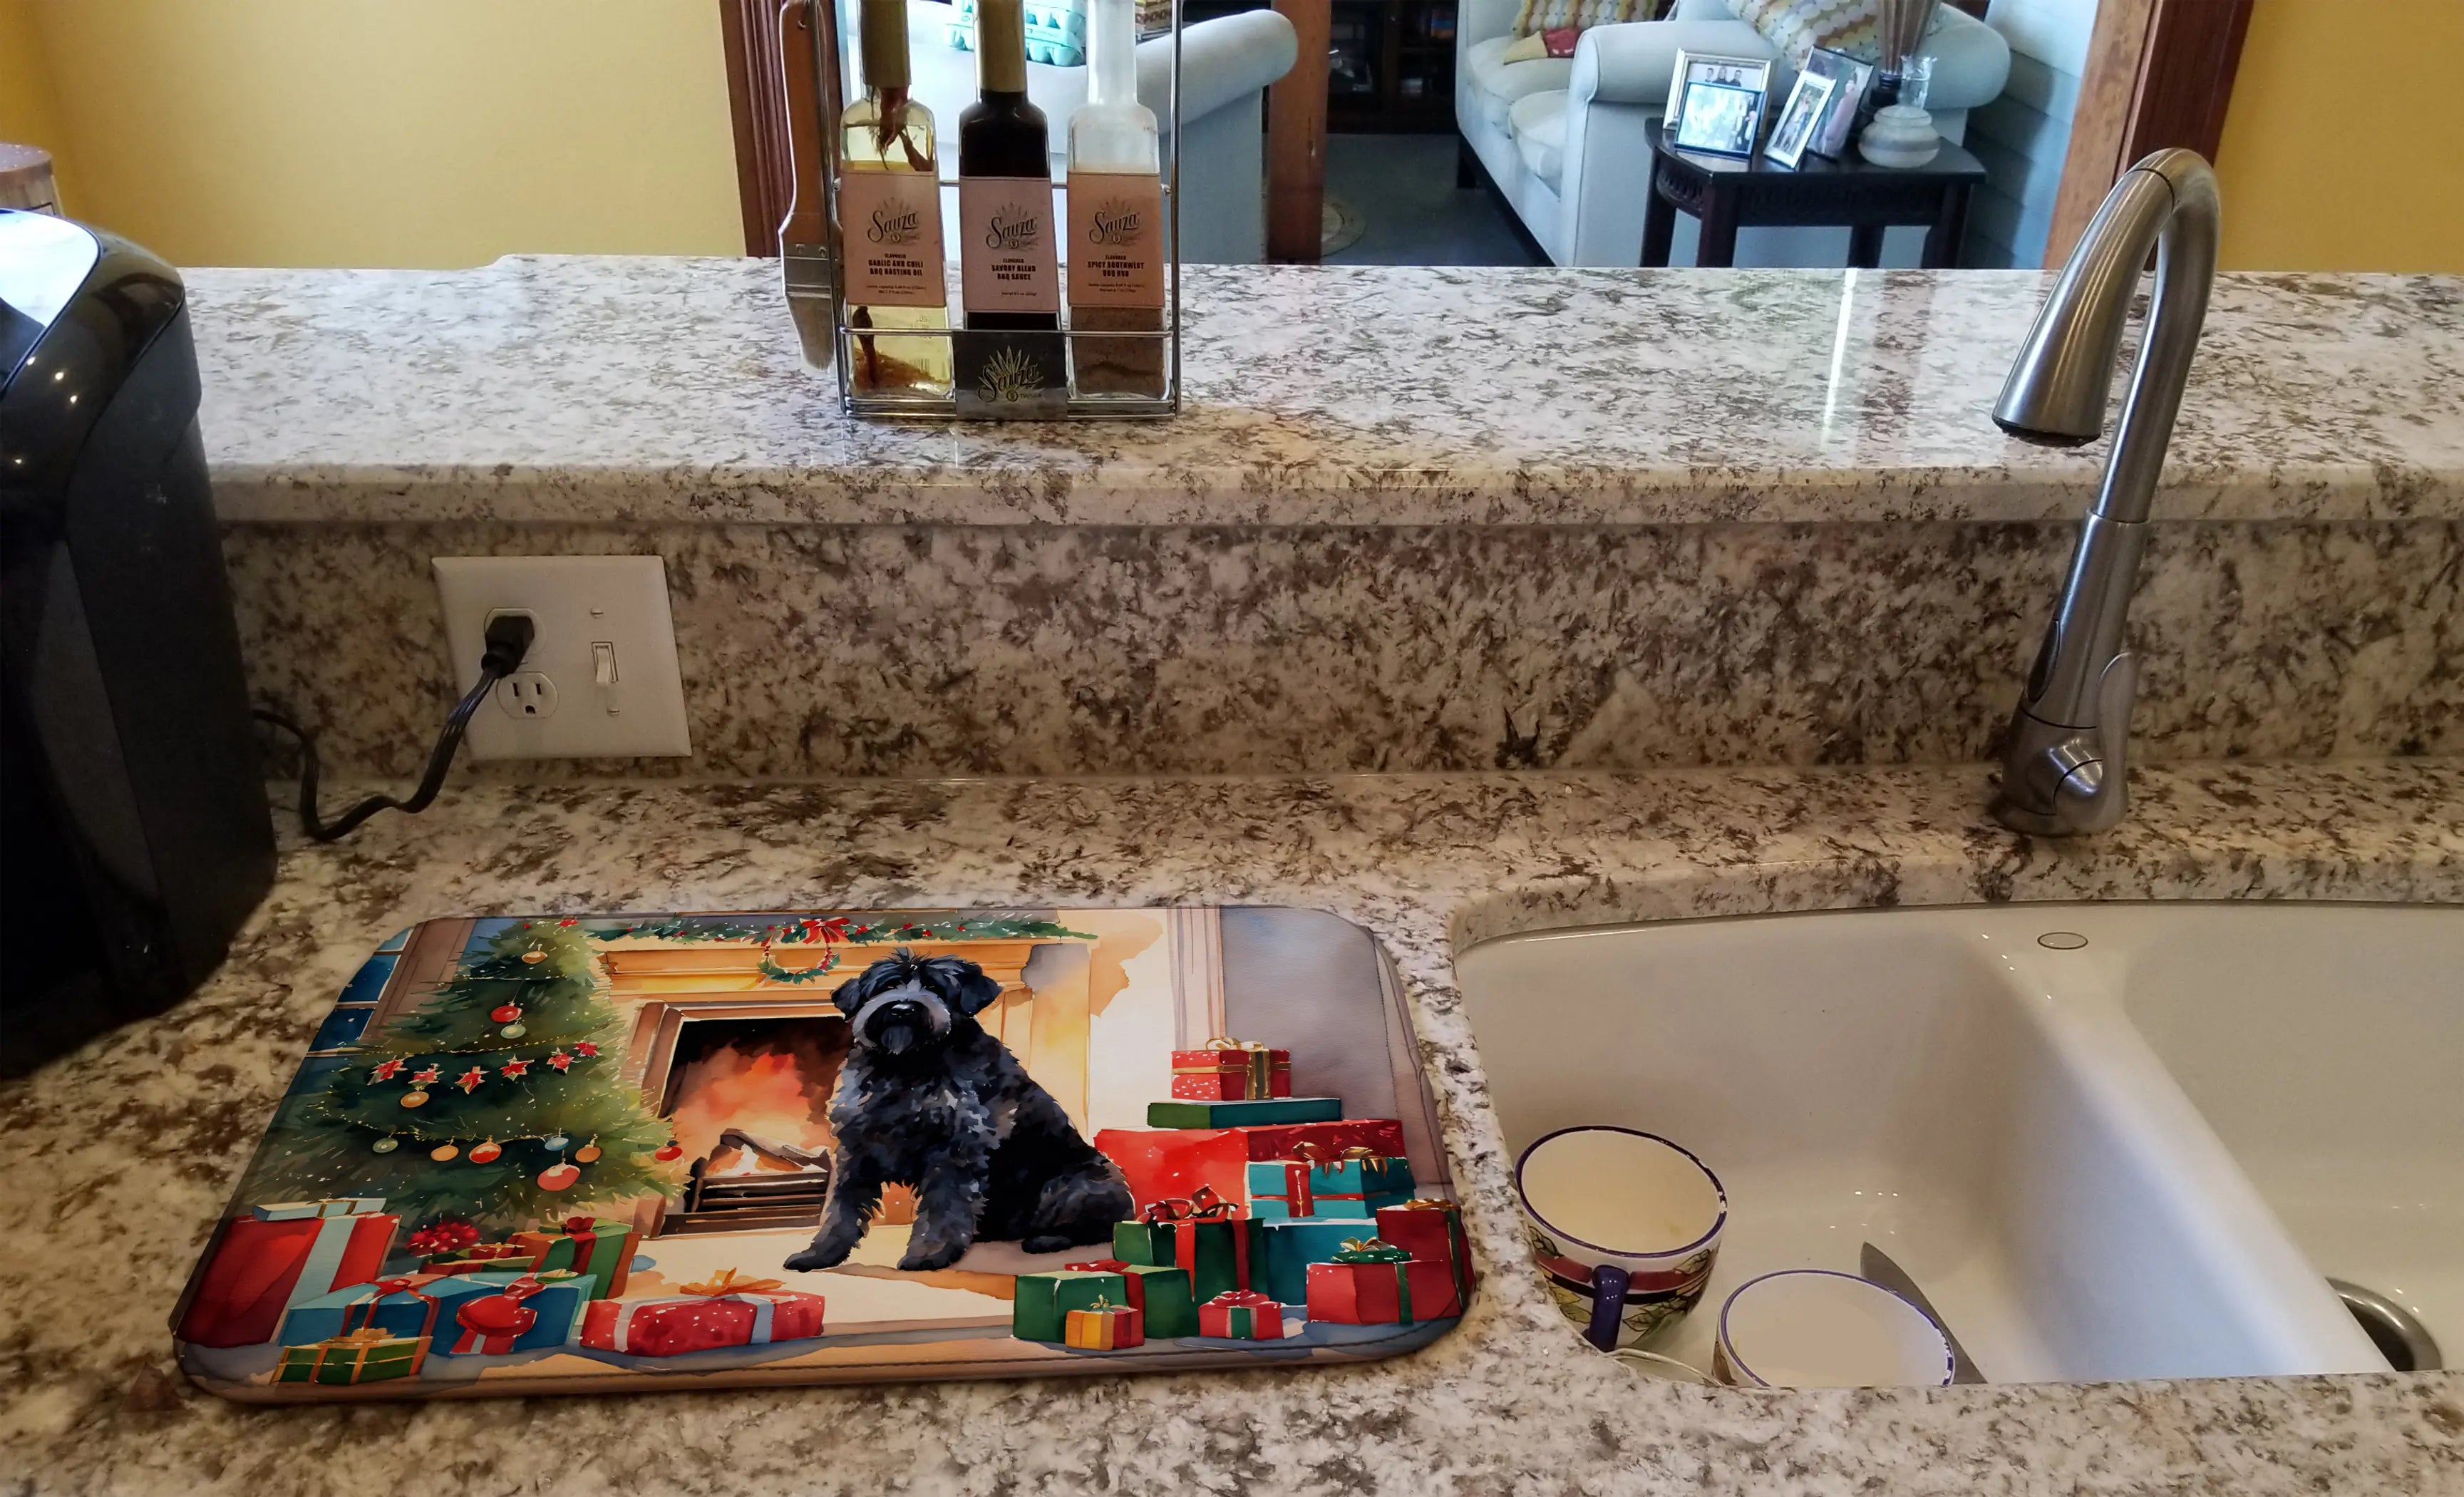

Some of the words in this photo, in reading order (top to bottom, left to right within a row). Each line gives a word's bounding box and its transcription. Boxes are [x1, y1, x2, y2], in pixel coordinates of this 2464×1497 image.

[867, 210, 918, 242] Sauza
[986, 217, 1036, 249] Sauza
[1089, 211, 1139, 244] Sauza
[978, 364, 1043, 403] Sauza
